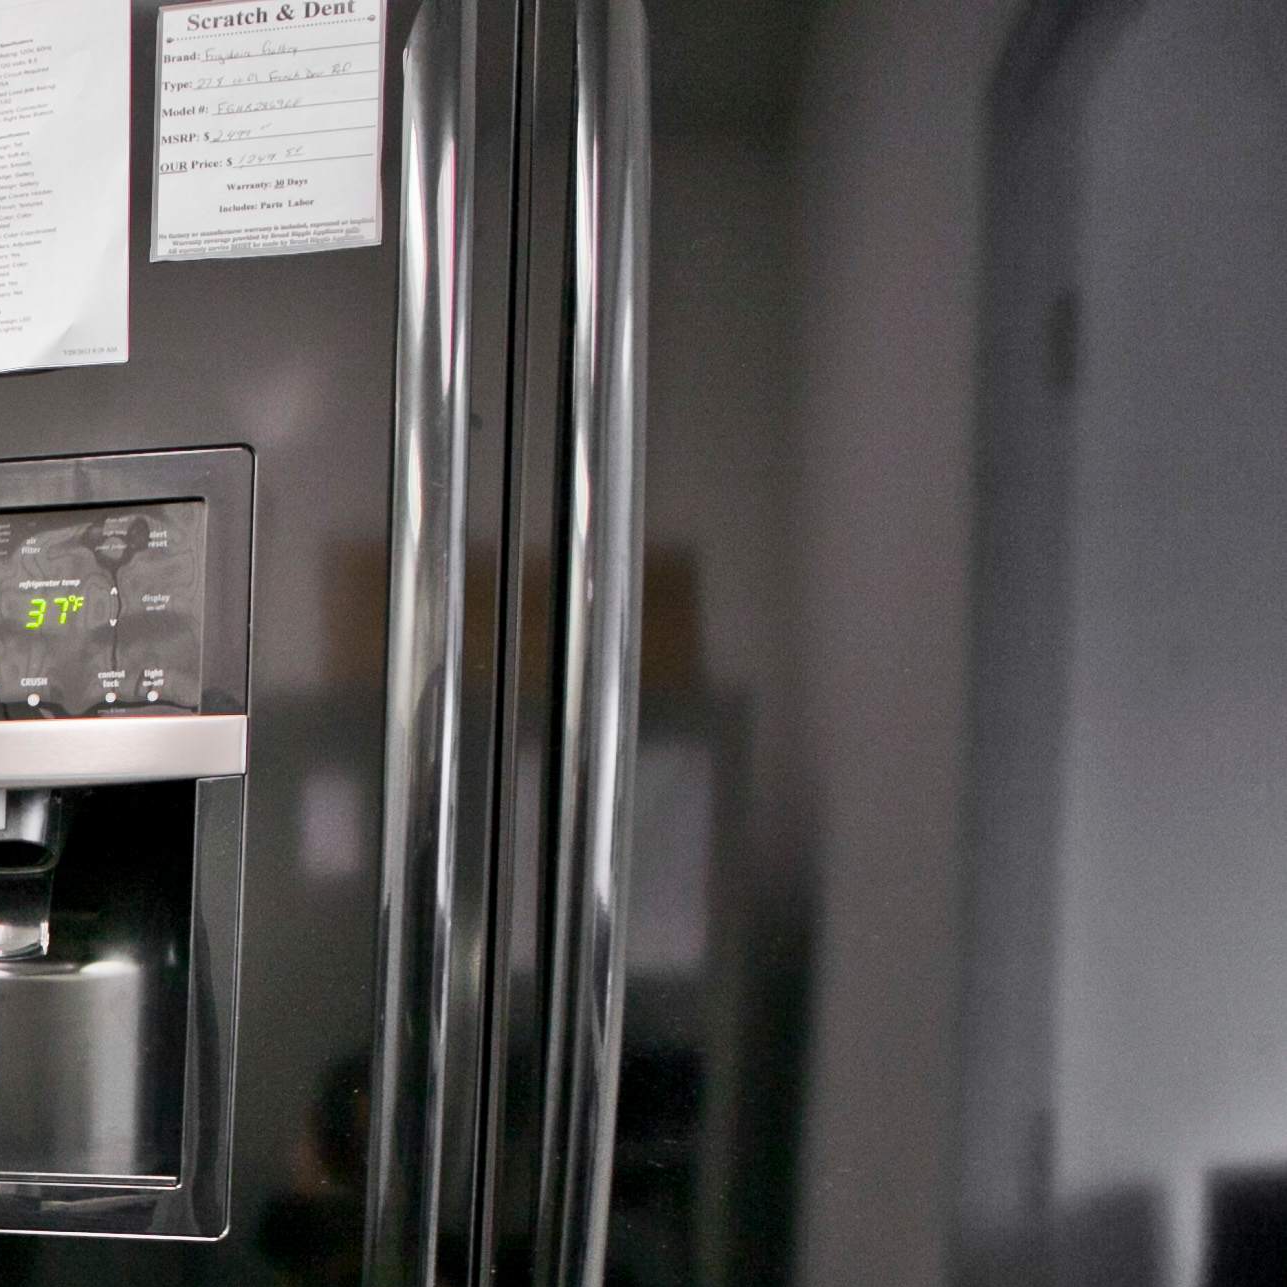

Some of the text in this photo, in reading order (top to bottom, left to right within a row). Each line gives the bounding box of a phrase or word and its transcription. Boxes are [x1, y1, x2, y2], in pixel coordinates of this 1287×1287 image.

[186, 0, 356, 32] Scratch & Dent
[163, 52, 201, 64] Brand:
[162, 82, 193, 92] Type:
[162, 105, 195, 118] Model
[161, 132, 200, 145] MSRP:
[160, 161, 188, 174] OUR
[191, 158, 223, 170] Price:
[226, 180, 272, 192] Warranty:
[287, 178, 308, 188] Days
[219, 199, 315, 214] Includes: Parts Labor
[149, 530, 167, 538] alert
[21, 546, 41, 555] filter
[19, 579, 81, 590] refrigerator temp
[142, 594, 170, 604] display
[98, 670, 126, 678] control
[144, 669, 164, 678] light
[20, 677, 48, 687] CRUSH
[102, 679, 120, 688] lock
